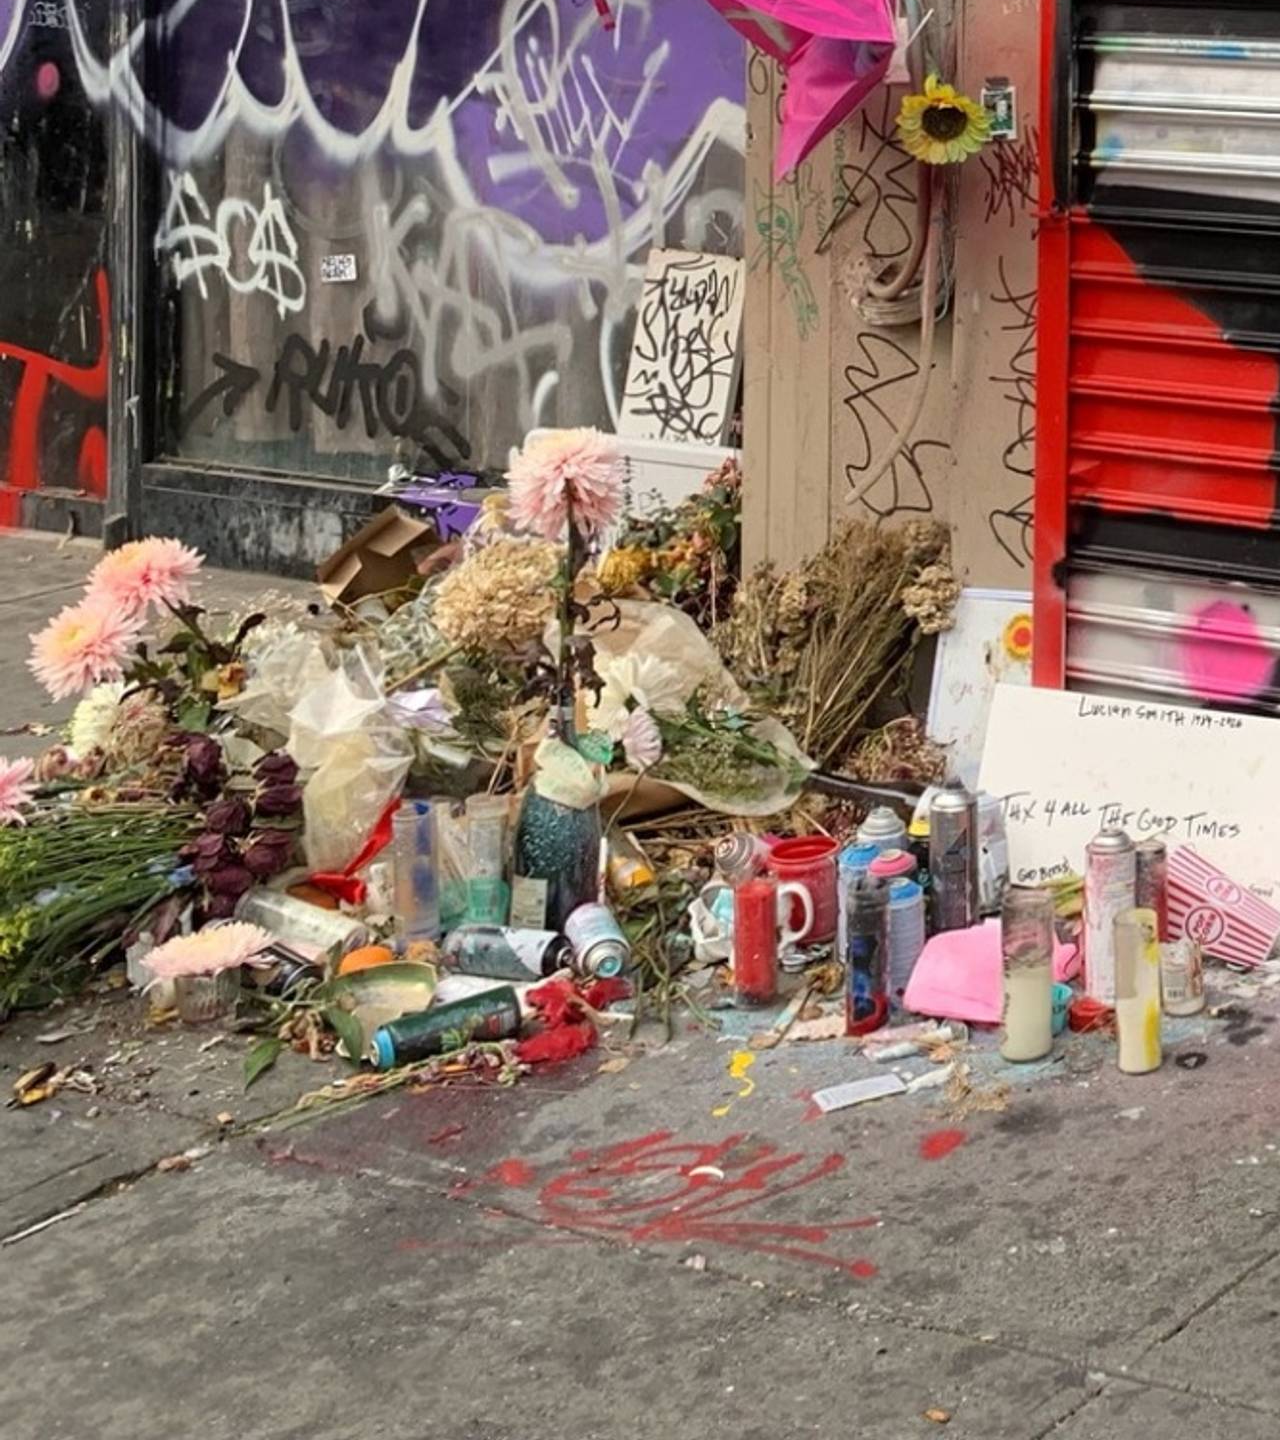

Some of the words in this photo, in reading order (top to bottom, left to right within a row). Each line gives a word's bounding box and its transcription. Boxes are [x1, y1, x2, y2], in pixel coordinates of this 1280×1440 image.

[997, 792, 1038, 827] THX
[1044, 800, 1057, 827] 4
[1059, 799, 1091, 817] ALL
[1098, 802, 1136, 828] THE
[1183, 812, 1241, 839] TIMES
